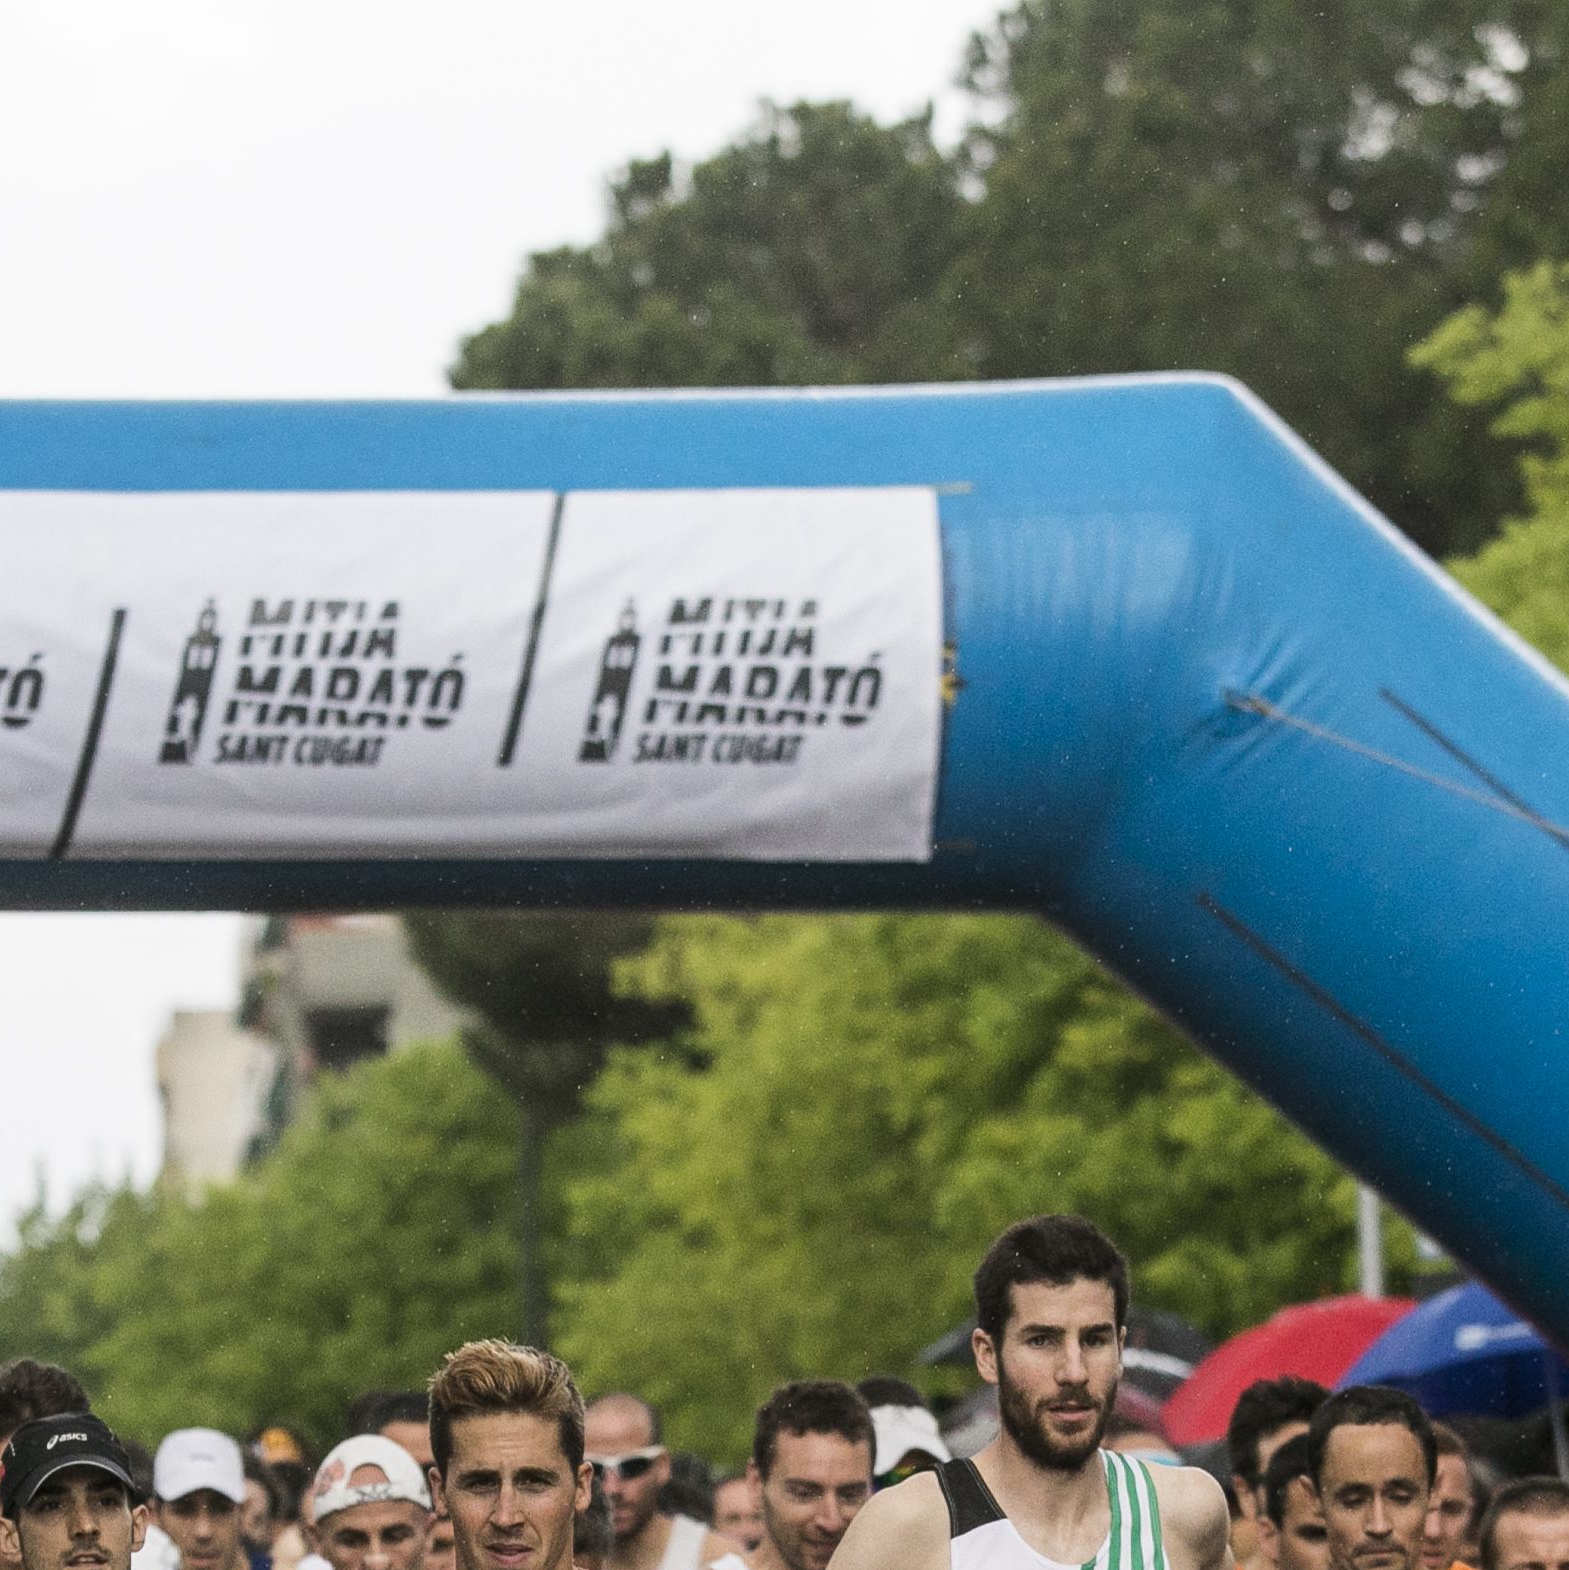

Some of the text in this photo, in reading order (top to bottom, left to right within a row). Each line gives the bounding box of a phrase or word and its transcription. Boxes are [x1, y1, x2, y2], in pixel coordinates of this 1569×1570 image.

[223, 651, 464, 730] MARATÓ
[641, 650, 881, 728] MARATÓ
[214, 735, 386, 766] SANT CUGAT
[633, 734, 804, 764] SANT CUGAT
